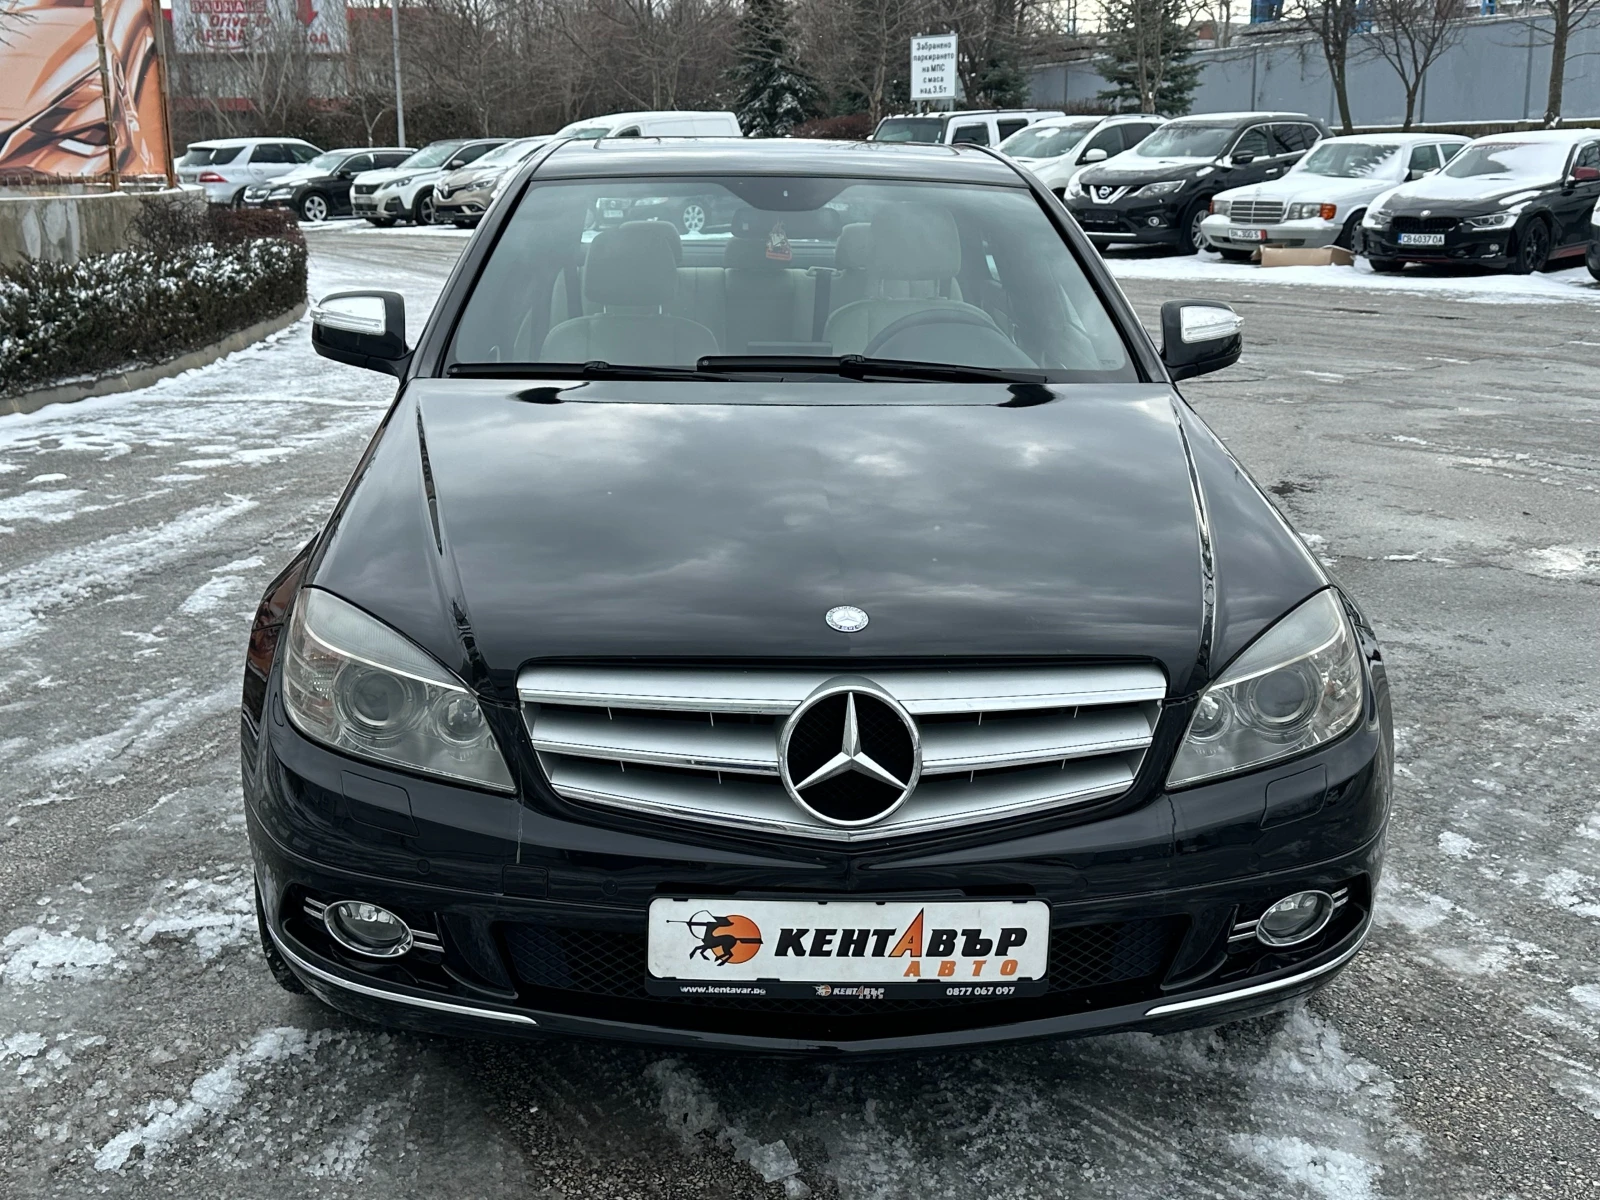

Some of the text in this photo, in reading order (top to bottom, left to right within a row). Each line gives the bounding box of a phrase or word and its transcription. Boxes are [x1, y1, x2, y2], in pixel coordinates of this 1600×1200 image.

[916, 42, 952, 51] Забранено
[913, 52, 955, 62] паркирането
[930, 63, 946, 72] МПС
[1413, 235, 1432, 243] 6037
[774, 907, 1028, 957] КЕНТАВЪР
[903, 959, 1019, 977] АВТО
[946, 986, 1016, 996] 0877 067 097
